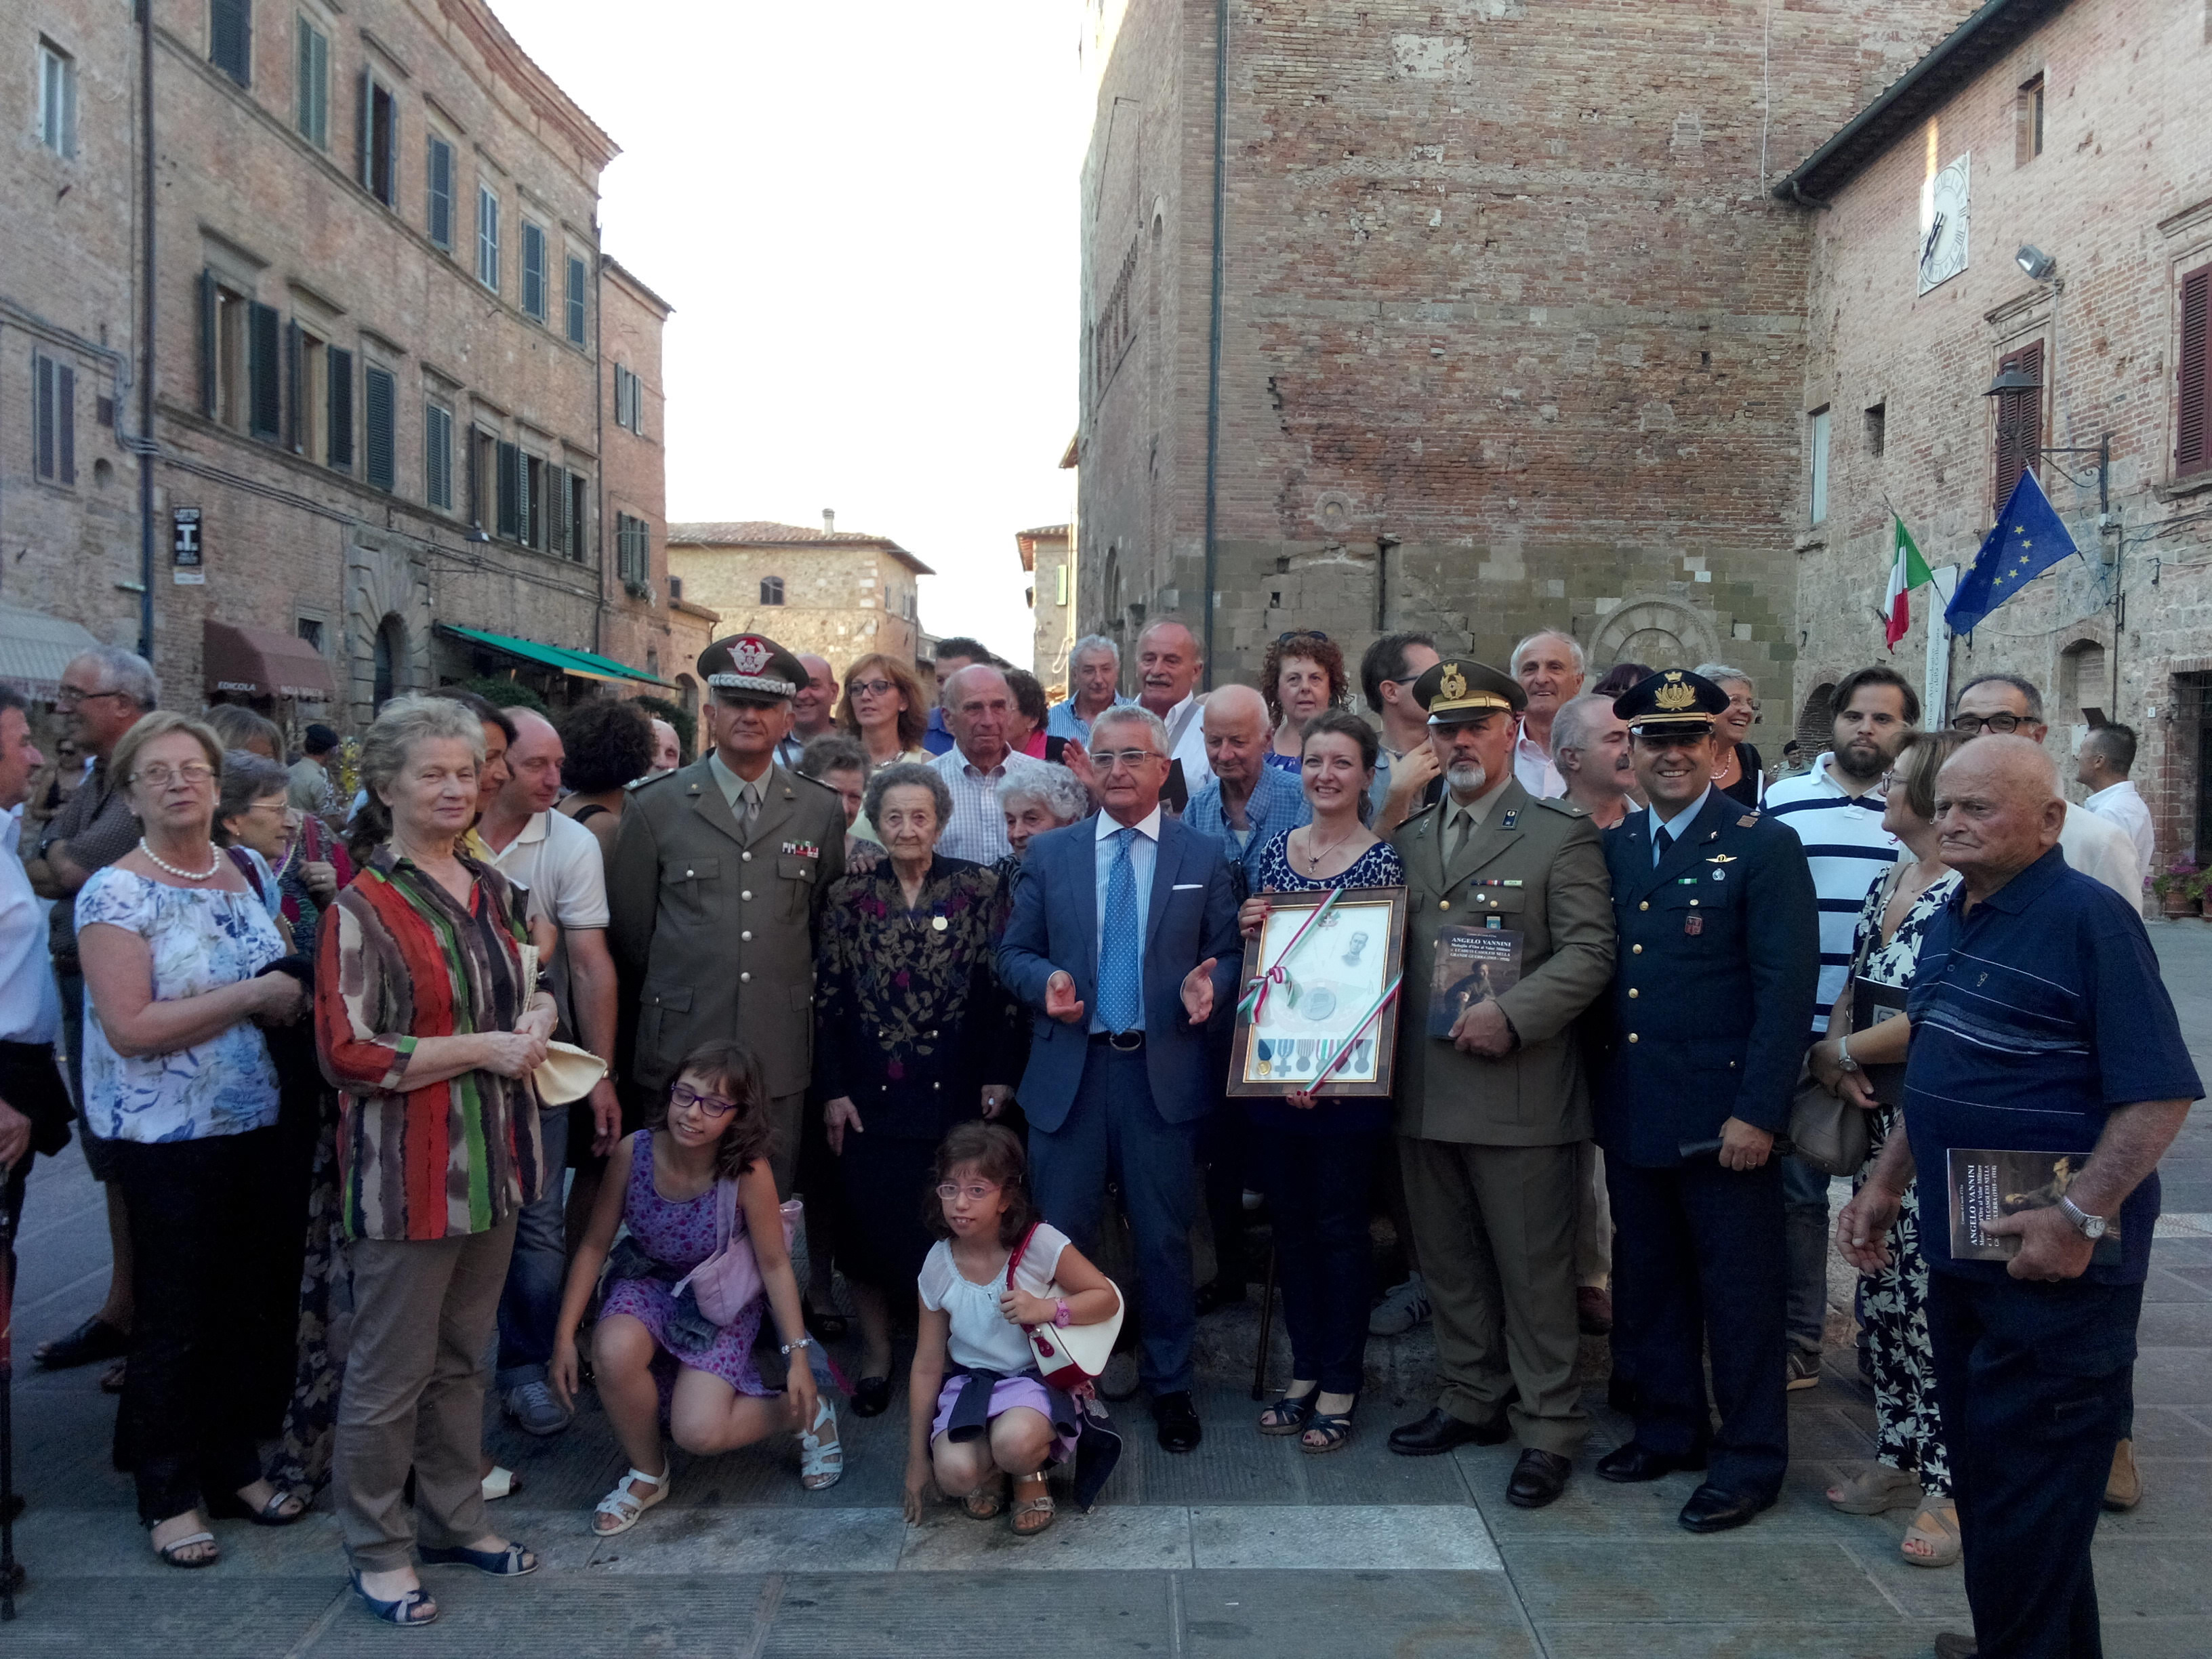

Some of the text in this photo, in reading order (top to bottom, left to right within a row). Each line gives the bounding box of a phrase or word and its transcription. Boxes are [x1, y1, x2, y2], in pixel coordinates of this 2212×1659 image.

[177, 523, 197, 551] T
[218, 681, 256, 691] EDICOLA
[1969, 1206, 1977, 1245] ANGELO
